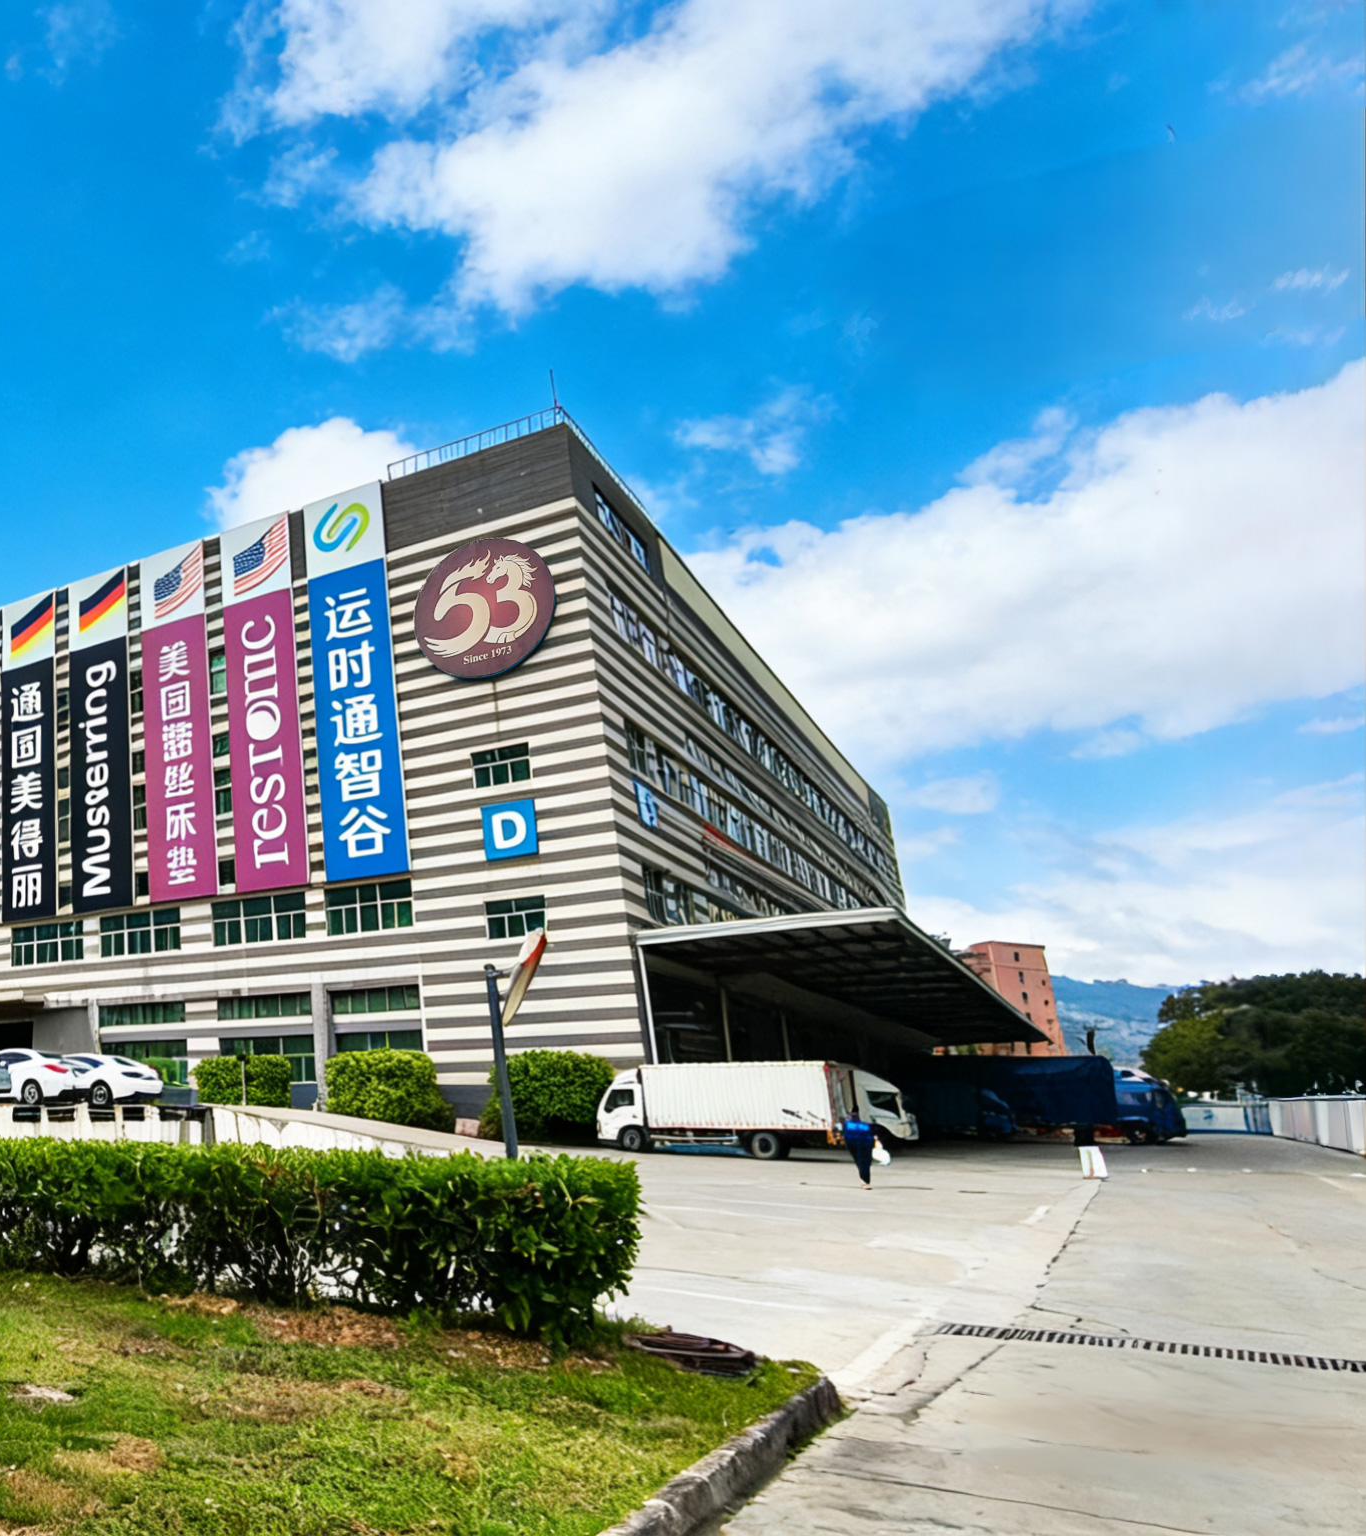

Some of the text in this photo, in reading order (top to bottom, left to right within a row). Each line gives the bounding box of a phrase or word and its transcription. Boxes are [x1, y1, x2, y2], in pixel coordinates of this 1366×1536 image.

[423, 549, 538, 658] 53
[463, 645, 513, 665] Since 1973
[324, 587, 392, 860] 运时通智谷
[491, 811, 527, 850] D
